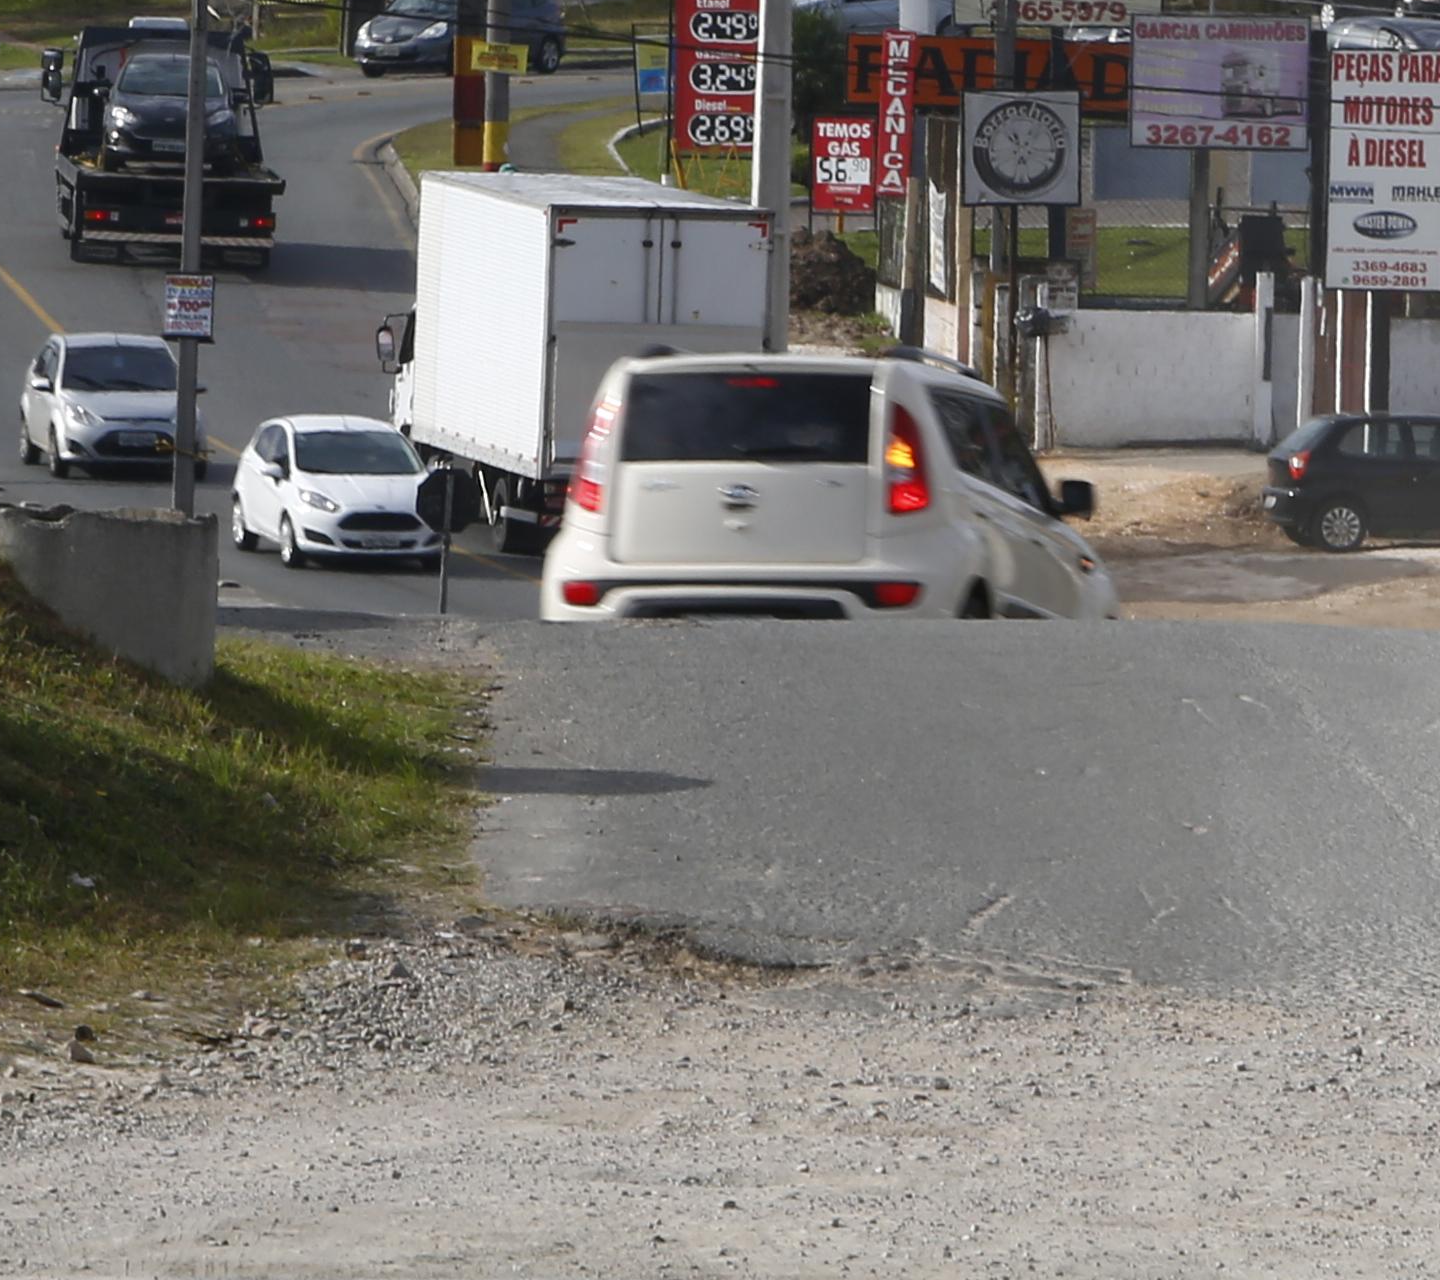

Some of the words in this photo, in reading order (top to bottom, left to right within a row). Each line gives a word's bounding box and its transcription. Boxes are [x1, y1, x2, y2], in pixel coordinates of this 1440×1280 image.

[1136, 22, 1199, 40] GARCIA
[1205, 21, 1307, 41] CAMINHÕES
[1333, 53, 1393, 87] PEÇAS
[694, 99, 727, 111] Diesel
[881, 40, 910, 187] MECANICA
[1343, 96, 1434, 126] MOTORES
[817, 122, 871, 139] TEMOS
[1146, 124, 1291, 147] 3267-4162
[827, 137, 861, 157] GÁS
[1365, 138, 1427, 168] DIESEL
[1330, 186, 1374, 197] MWM
[1352, 274, 1428, 287] 9659-2801
